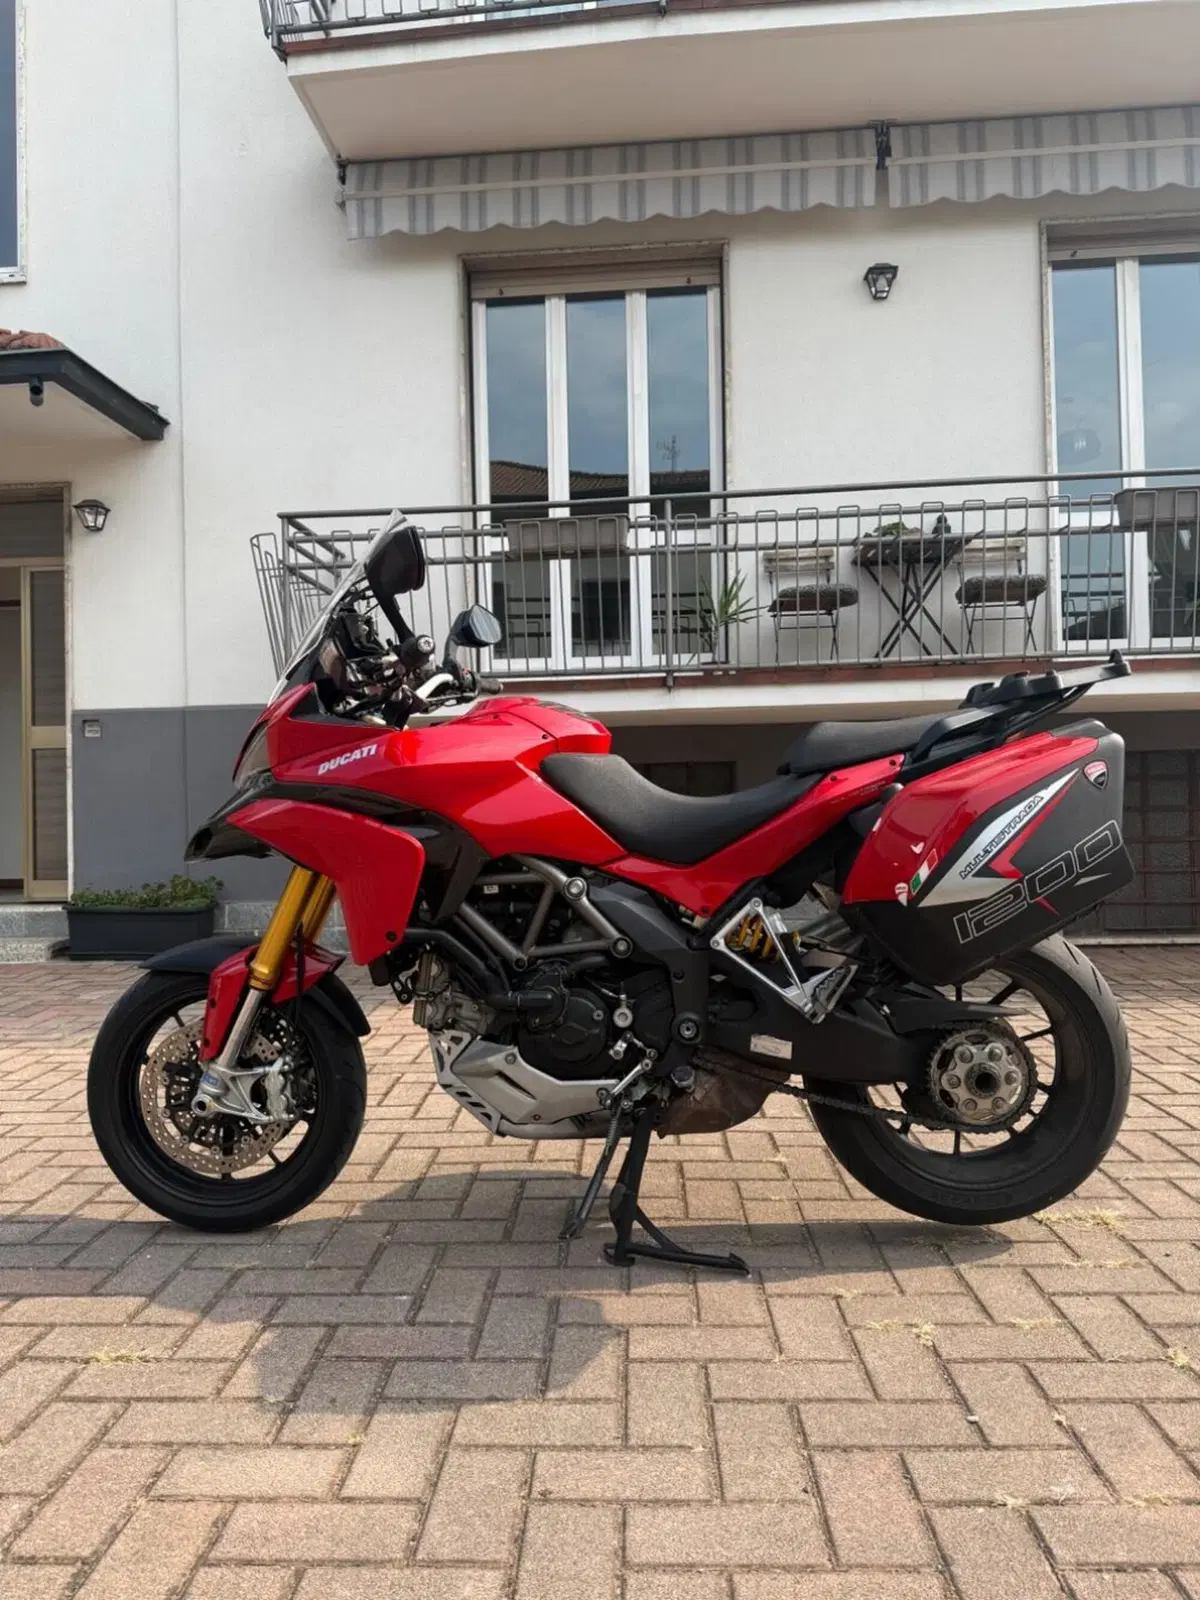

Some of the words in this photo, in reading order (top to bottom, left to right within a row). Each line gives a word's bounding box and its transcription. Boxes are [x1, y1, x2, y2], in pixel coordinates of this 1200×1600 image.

[317, 744, 378, 775] DUCATI
[957, 794, 1045, 880] MULTISTRADA
[953, 819, 1124, 944] 1200
